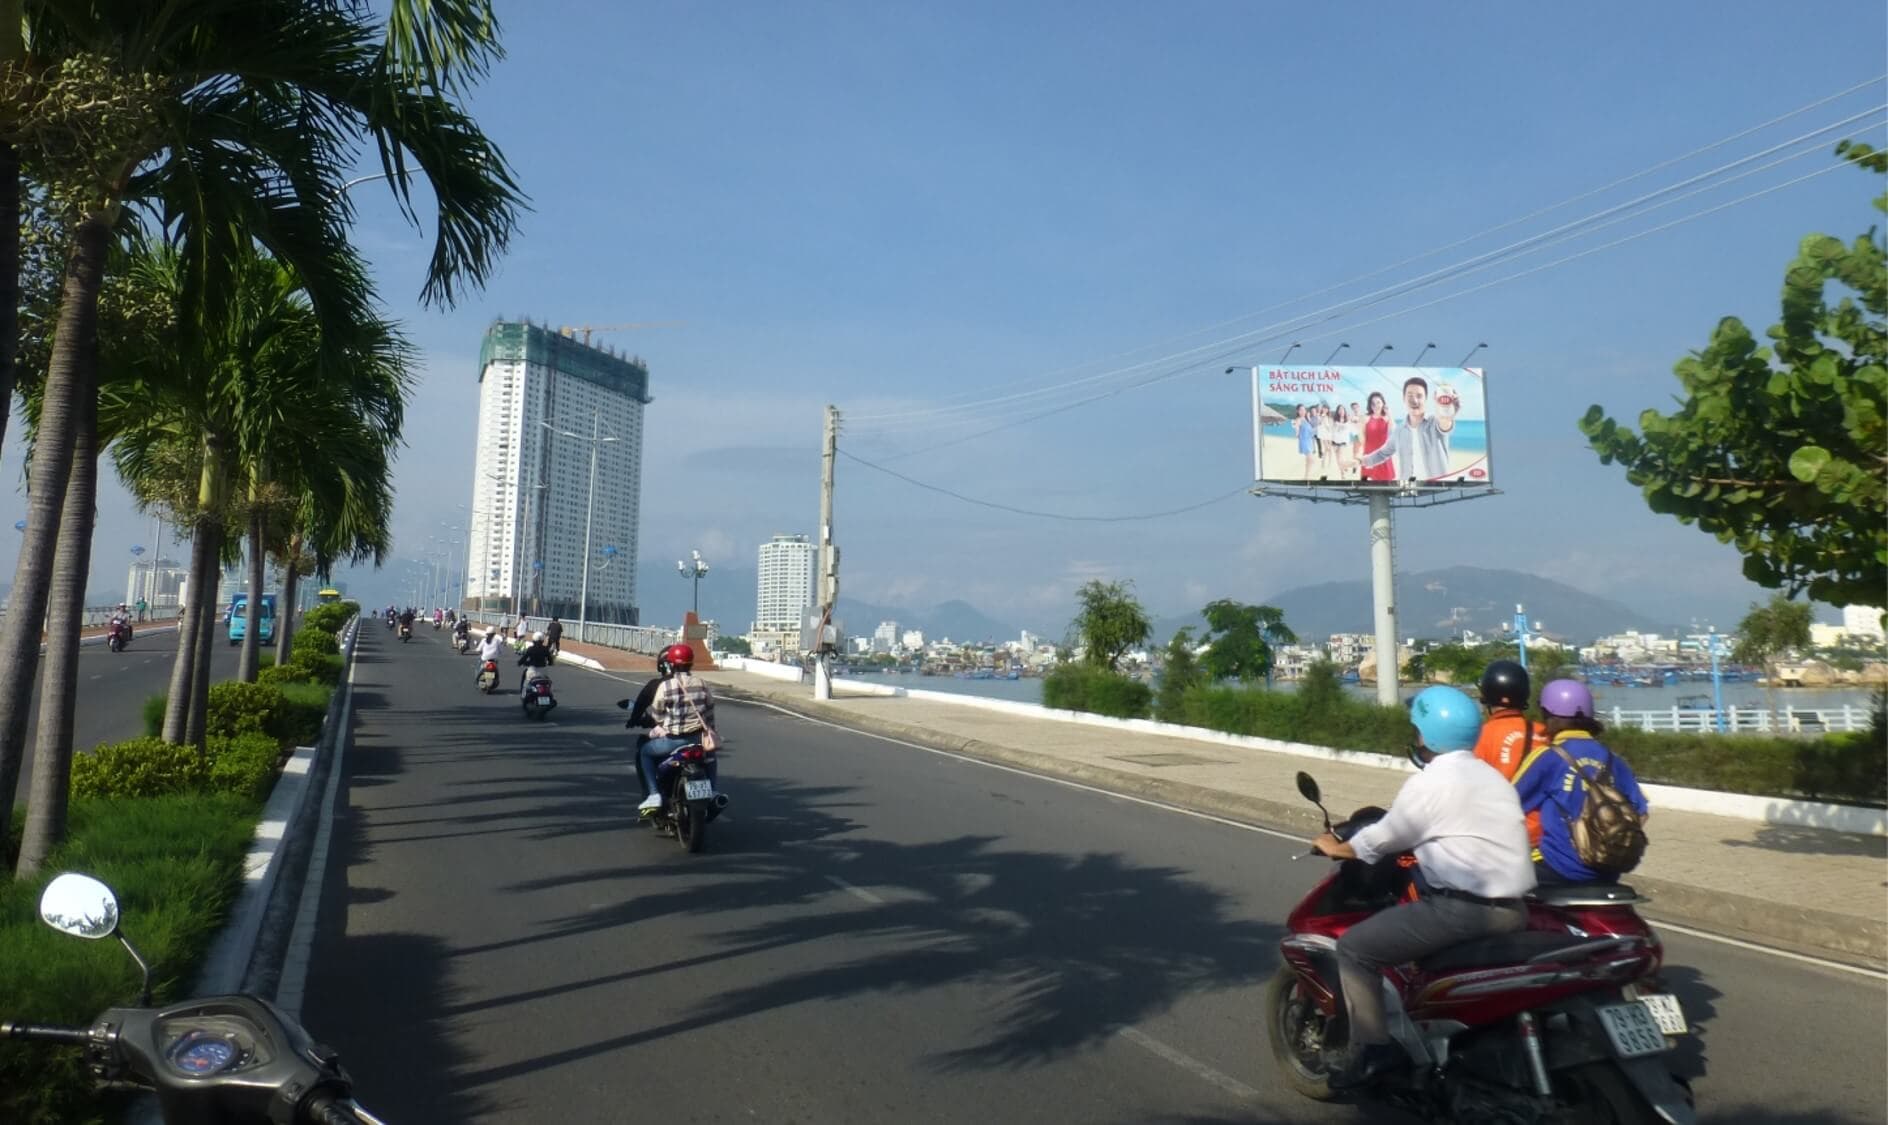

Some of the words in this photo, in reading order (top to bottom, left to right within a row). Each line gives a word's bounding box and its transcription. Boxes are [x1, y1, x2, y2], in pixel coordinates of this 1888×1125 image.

[1269, 369, 1288, 381] BẬT
[1291, 370, 1315, 381] LỊCH
[1269, 381, 1298, 392] SÁNG
[1316, 383, 1334, 392] TIN
